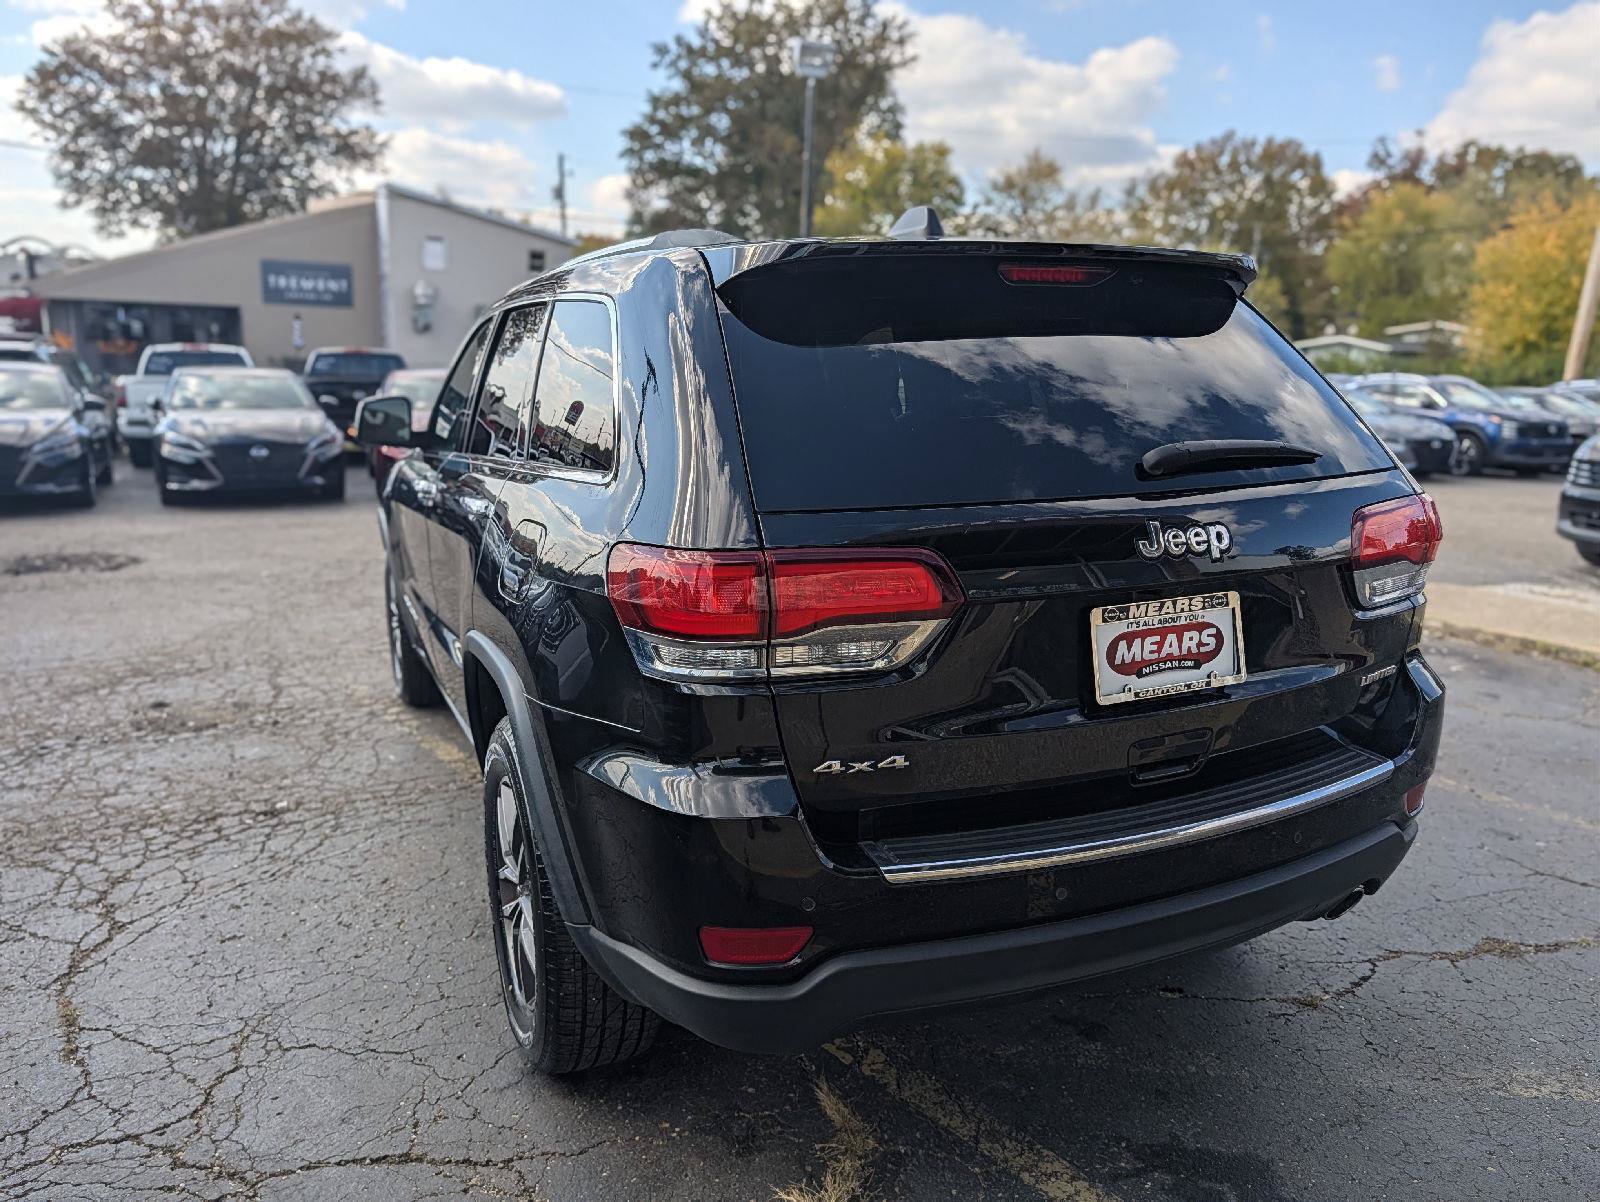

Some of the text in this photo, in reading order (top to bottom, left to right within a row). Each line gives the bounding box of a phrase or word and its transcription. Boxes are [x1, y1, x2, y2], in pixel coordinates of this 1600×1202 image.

[1138, 520, 1232, 560] Jeep
[1128, 596, 1204, 619] MEARS
[1126, 613, 1200, 630] IT'S ALL ABOUT YOU
[1114, 627, 1217, 666] MEARS
[1142, 660, 1195, 675] NISSAN.COM
[812, 754, 910, 775] 4x4
